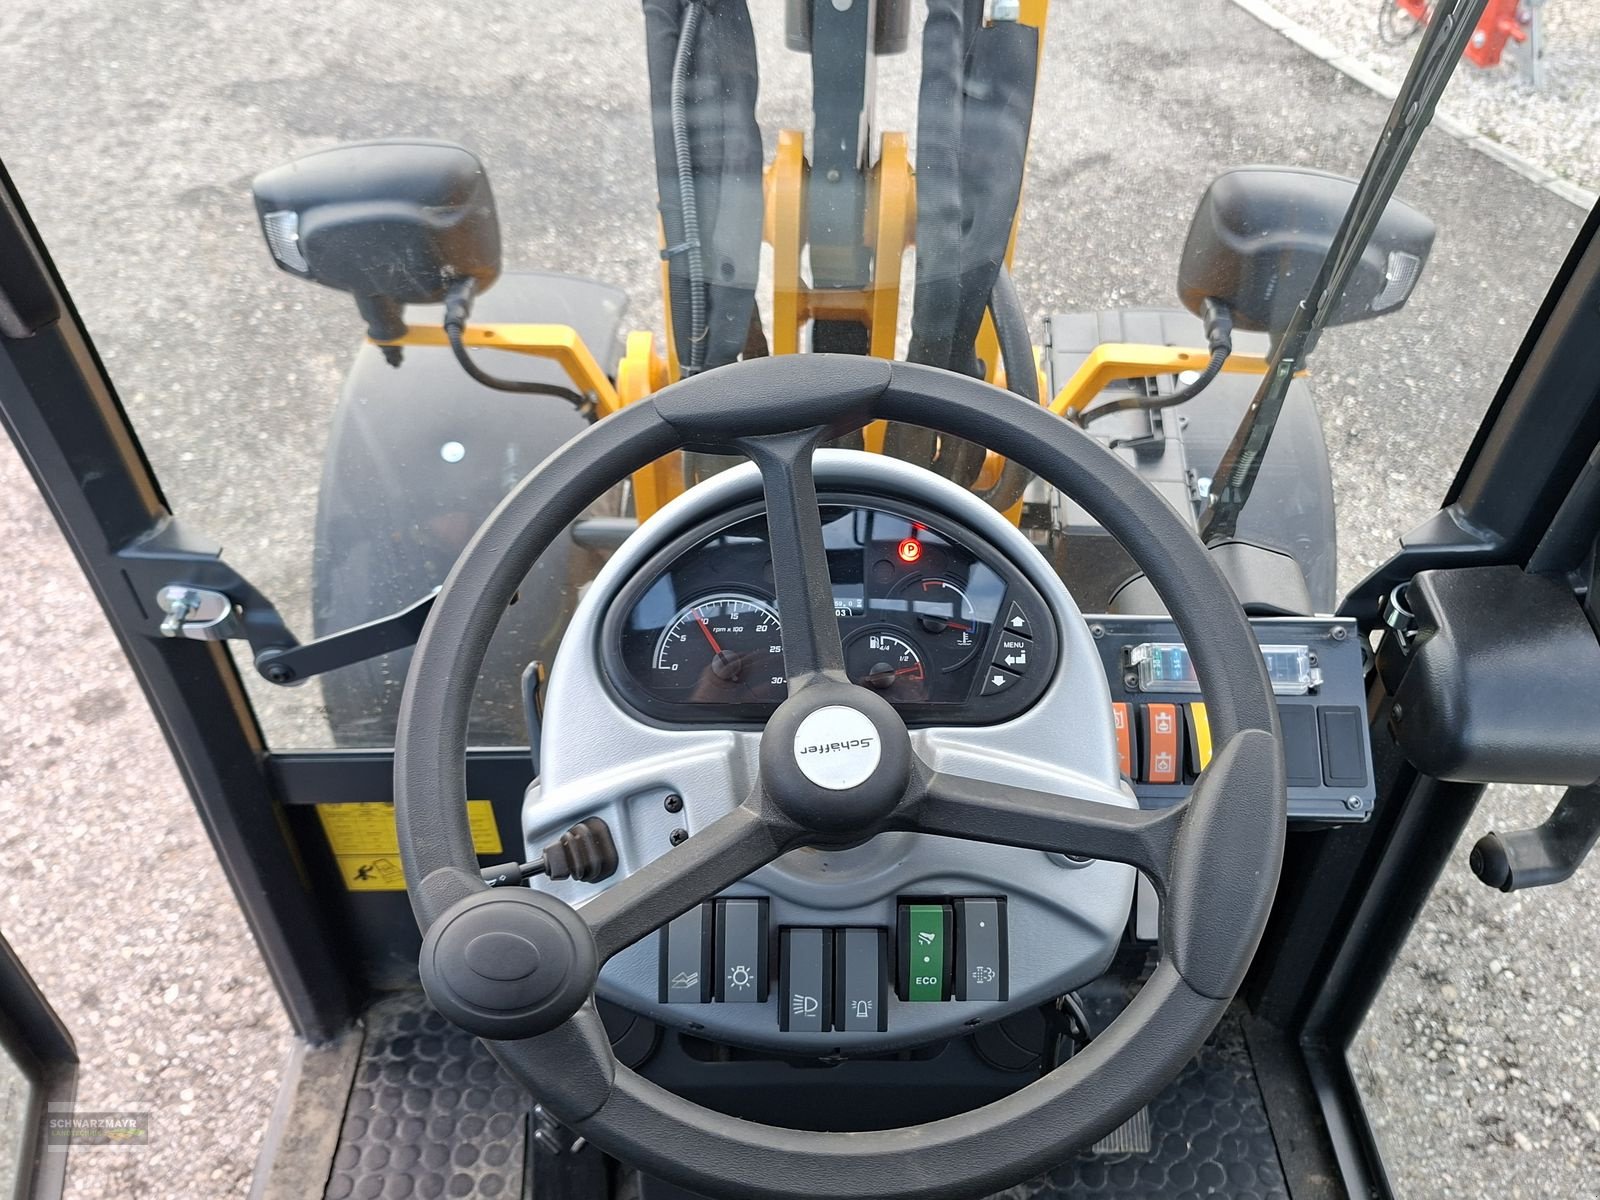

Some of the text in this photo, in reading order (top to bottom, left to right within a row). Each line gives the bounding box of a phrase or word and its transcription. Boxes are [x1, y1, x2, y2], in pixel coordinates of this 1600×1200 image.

[730, 612, 739, 620] 15
[680, 634, 687, 642] 5
[769, 645, 781, 653] 25
[671, 663, 679, 671] 0
[800, 737, 874, 754] Schäffer
[915, 976, 938, 985] ECO
